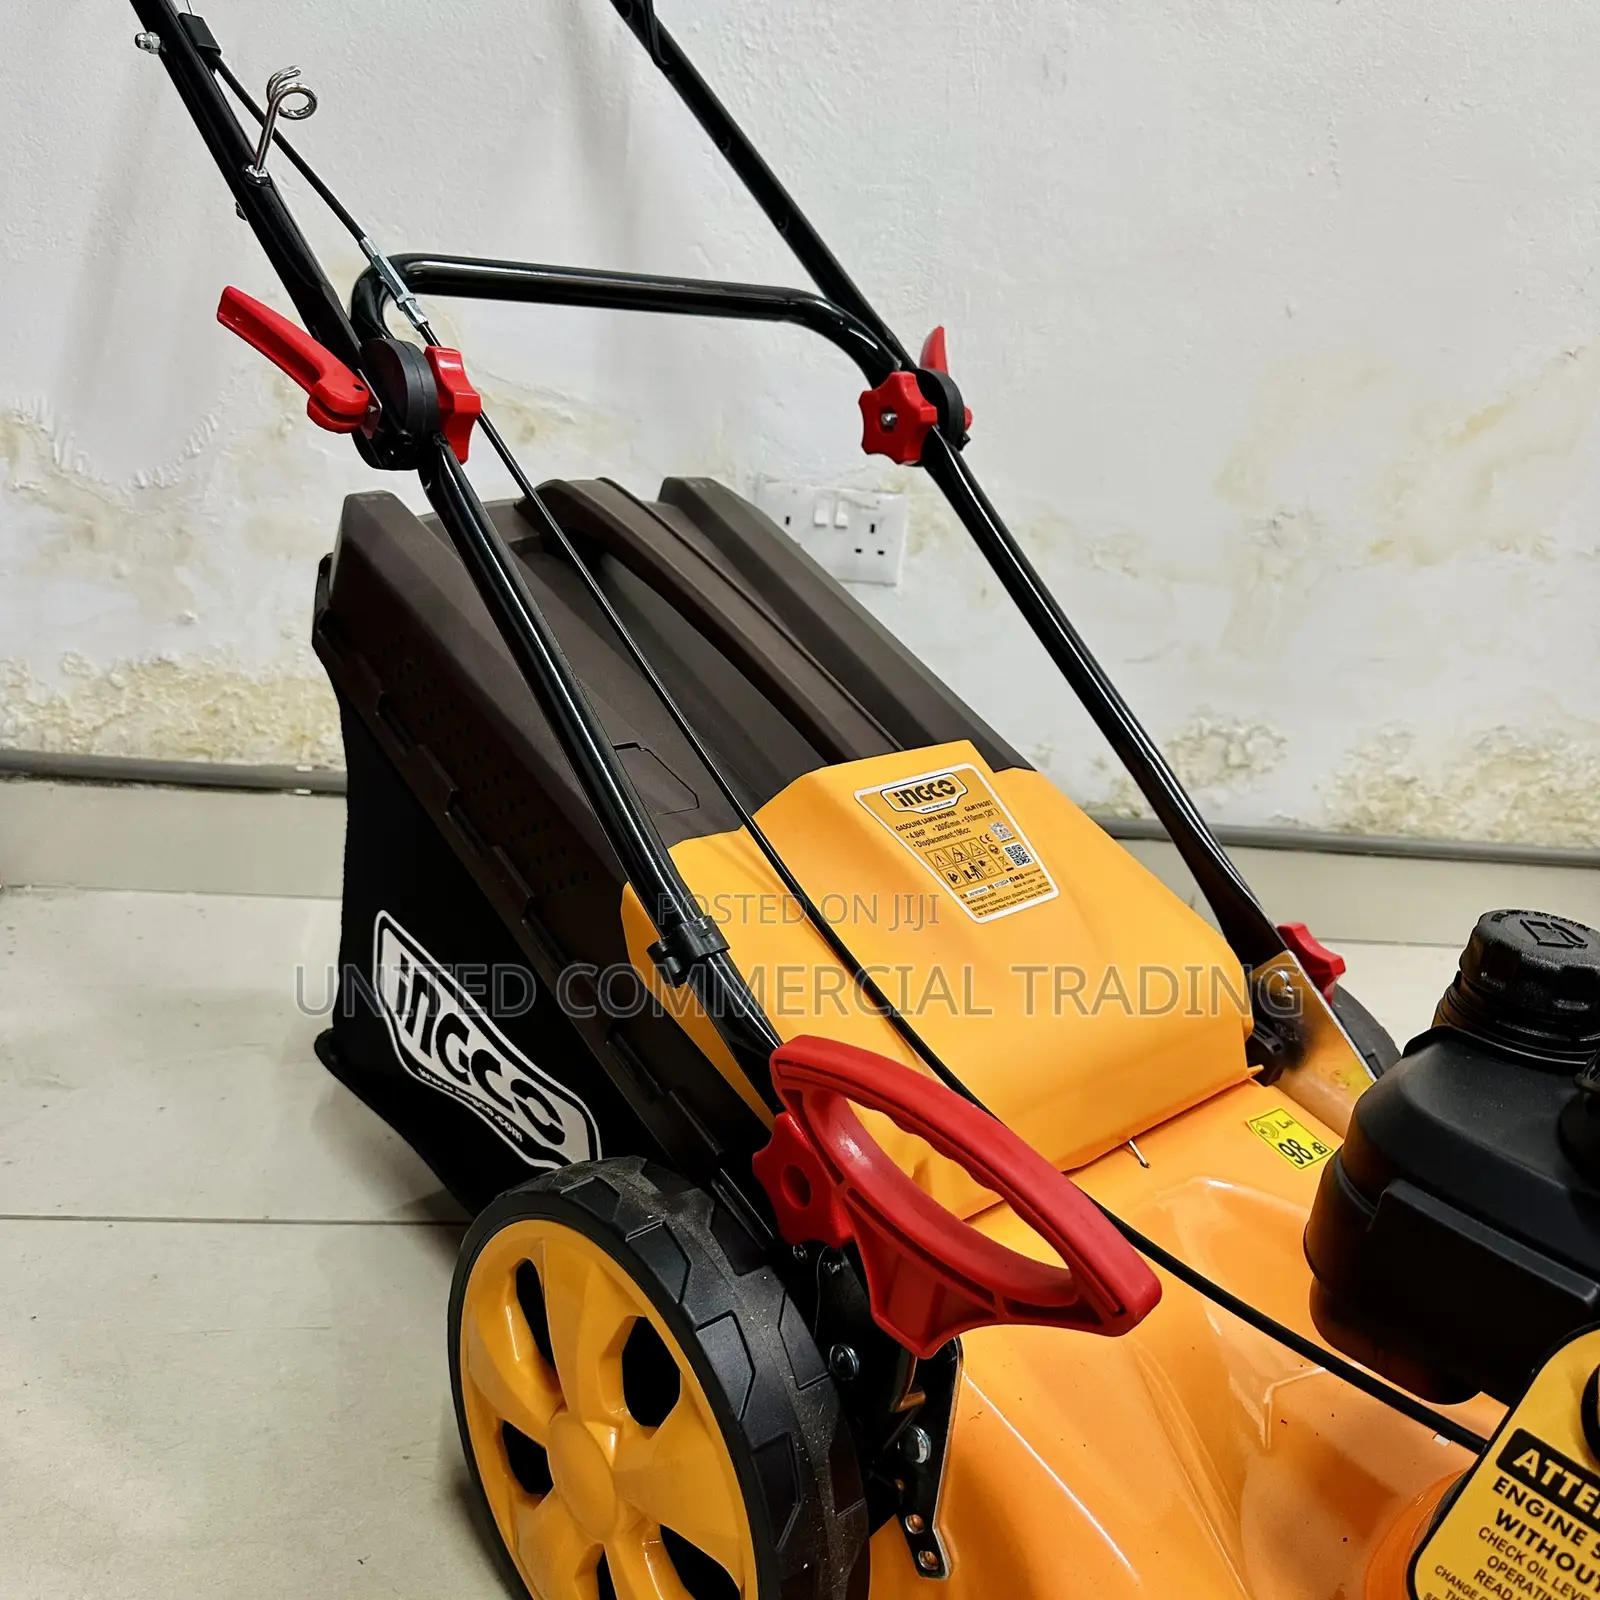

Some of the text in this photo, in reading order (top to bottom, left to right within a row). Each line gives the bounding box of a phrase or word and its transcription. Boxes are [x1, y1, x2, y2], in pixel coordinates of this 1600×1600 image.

[896, 810, 956, 831] GASOLINE LAWN MOWER
[1278, 1138, 1313, 1165] 98
[1492, 1475, 1588, 1547] ENGINE
[1478, 1526, 1528, 1566] CHECK
[1527, 1560, 1548, 1583] OIL
[1434, 1564, 1479, 1600] CHANGE
[1473, 1569, 1513, 1600] READ
[1487, 1555, 1558, 1600] OPERATIN
